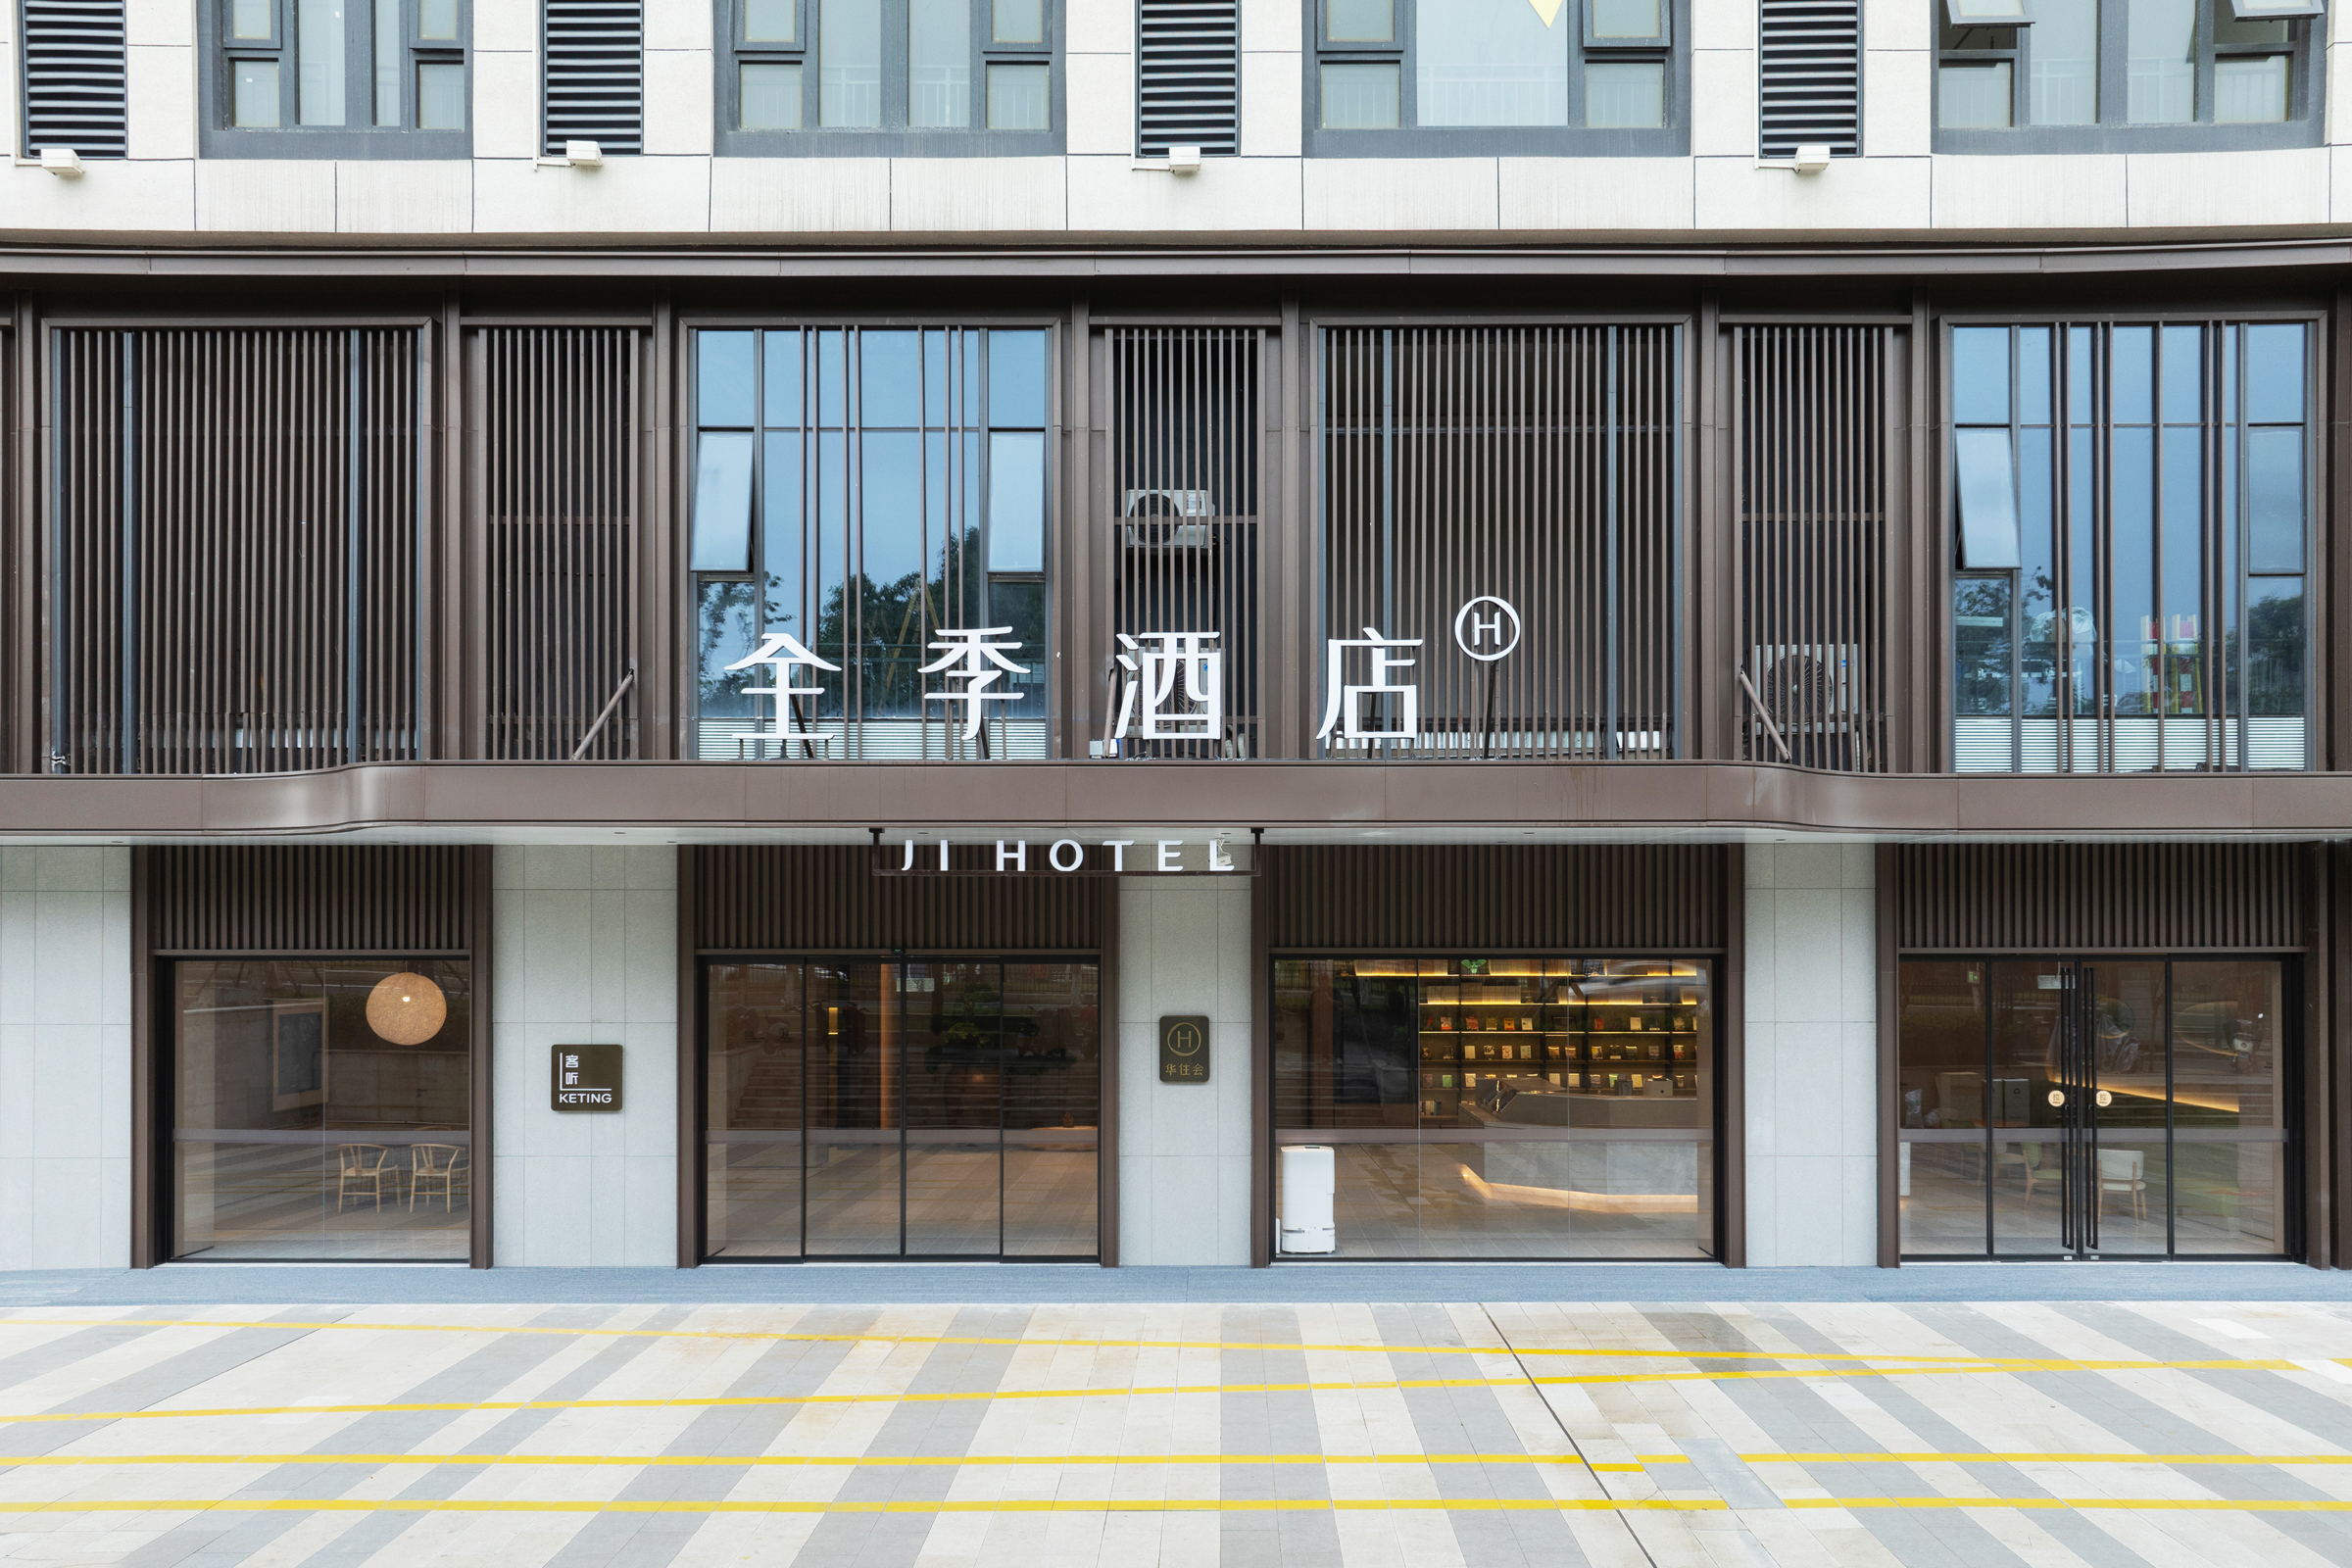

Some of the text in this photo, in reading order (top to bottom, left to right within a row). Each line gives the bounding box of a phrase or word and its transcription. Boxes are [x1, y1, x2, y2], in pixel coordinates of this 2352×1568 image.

[723, 625, 1424, 741] 全季酒店
[901, 839, 1234, 871] JI HOTEL
[1165, 1063, 1204, 1076] 华住会
[560, 1093, 612, 1103] KETING
